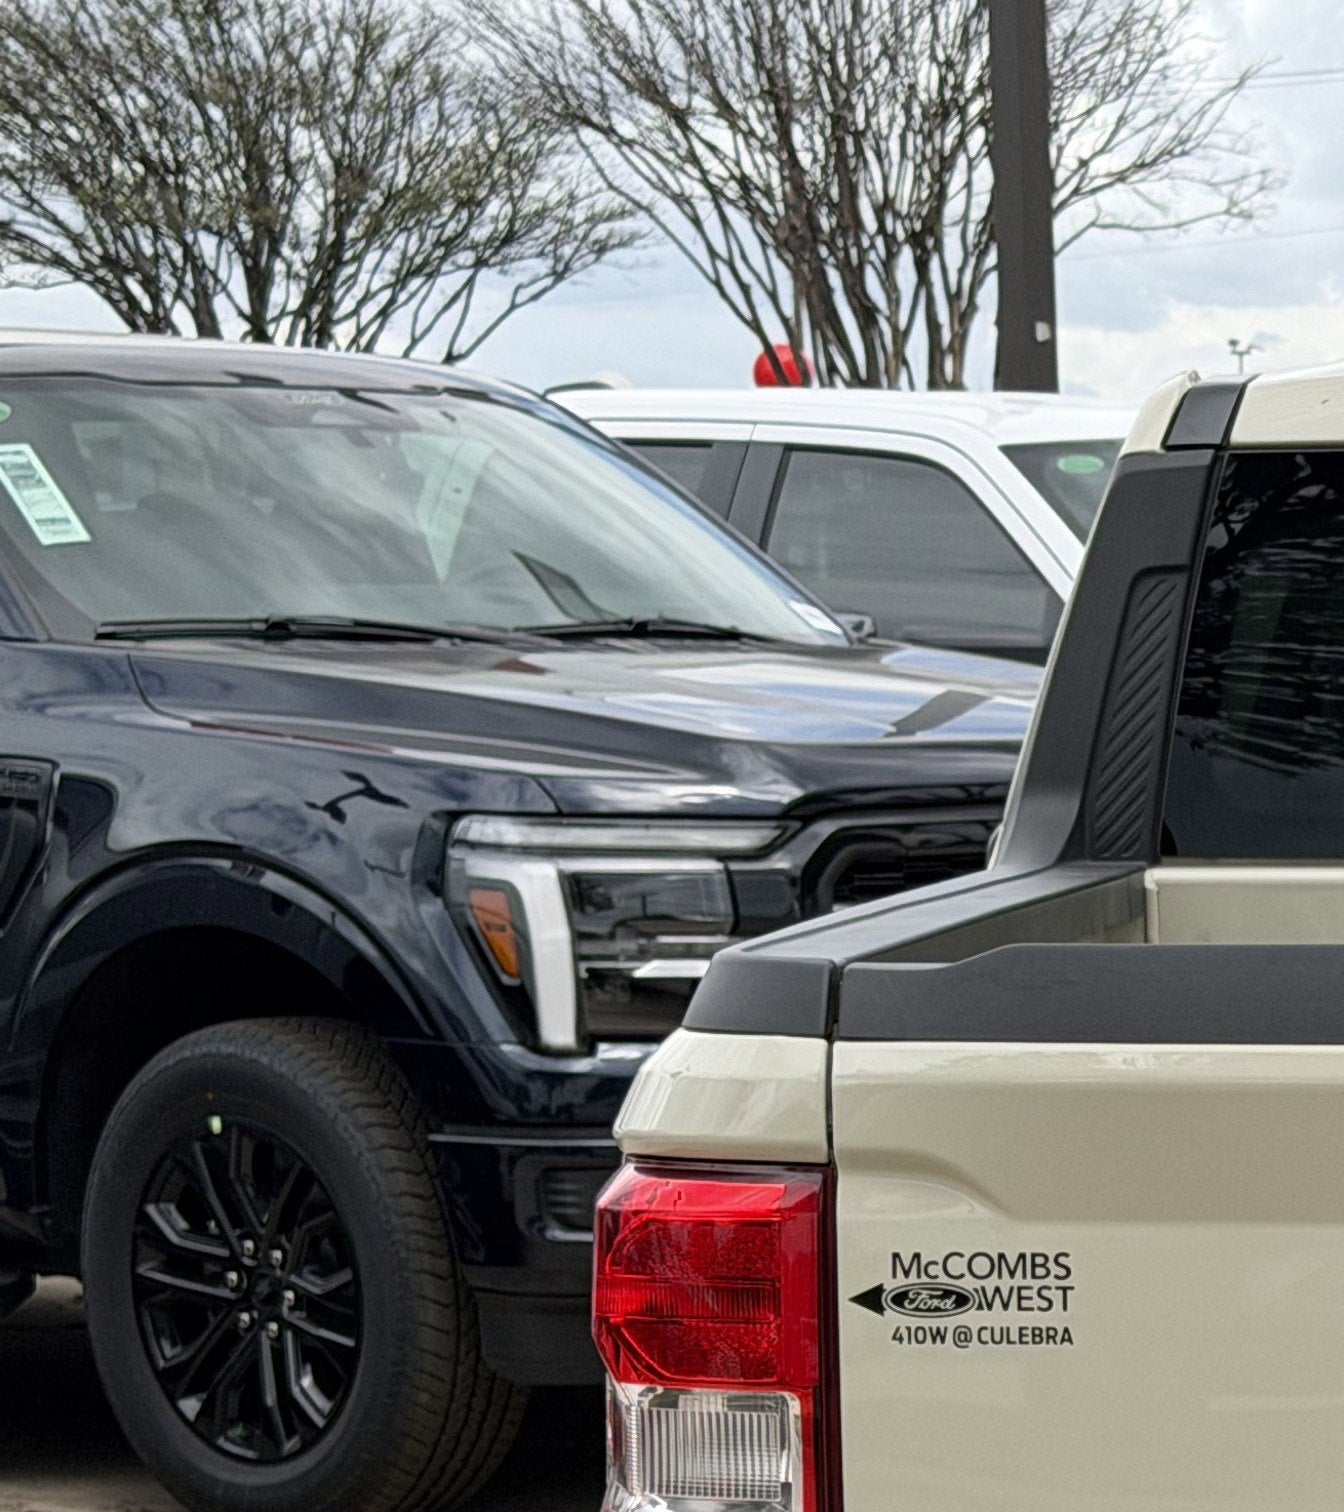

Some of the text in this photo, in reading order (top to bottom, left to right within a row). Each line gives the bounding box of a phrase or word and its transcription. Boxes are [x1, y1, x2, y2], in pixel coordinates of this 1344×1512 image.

[891, 1251, 1072, 1280] McCOMBS
[904, 1285, 1075, 1312] Ford WEST
[977, 1326, 1074, 1345] CULEBRA
